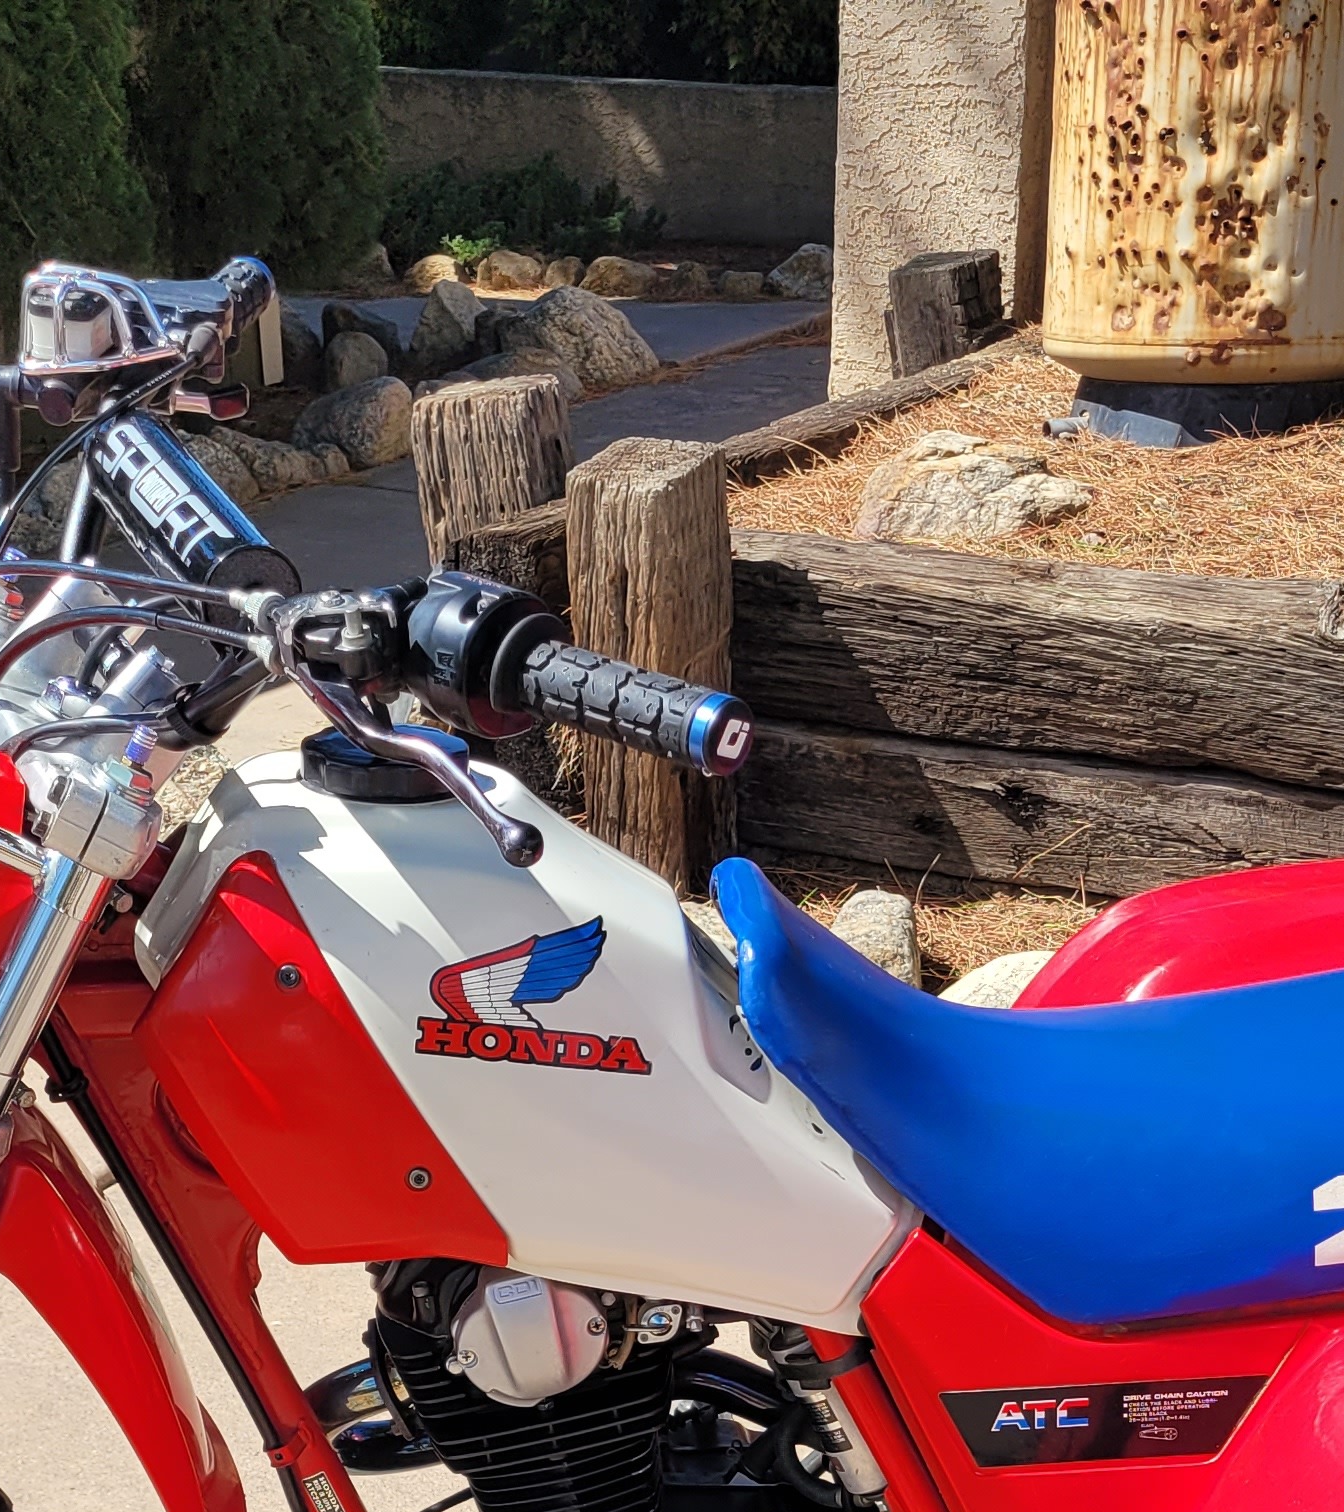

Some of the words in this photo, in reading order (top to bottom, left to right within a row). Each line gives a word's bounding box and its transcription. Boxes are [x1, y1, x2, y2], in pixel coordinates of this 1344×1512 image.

[95, 424, 235, 563] SPORT
[416, 1016, 652, 1075] HONDA
[1186, 1390, 1229, 1398] CAUTION
[990, 1397, 1090, 1432] ATC
[319, 1475, 340, 1512] HONDA
